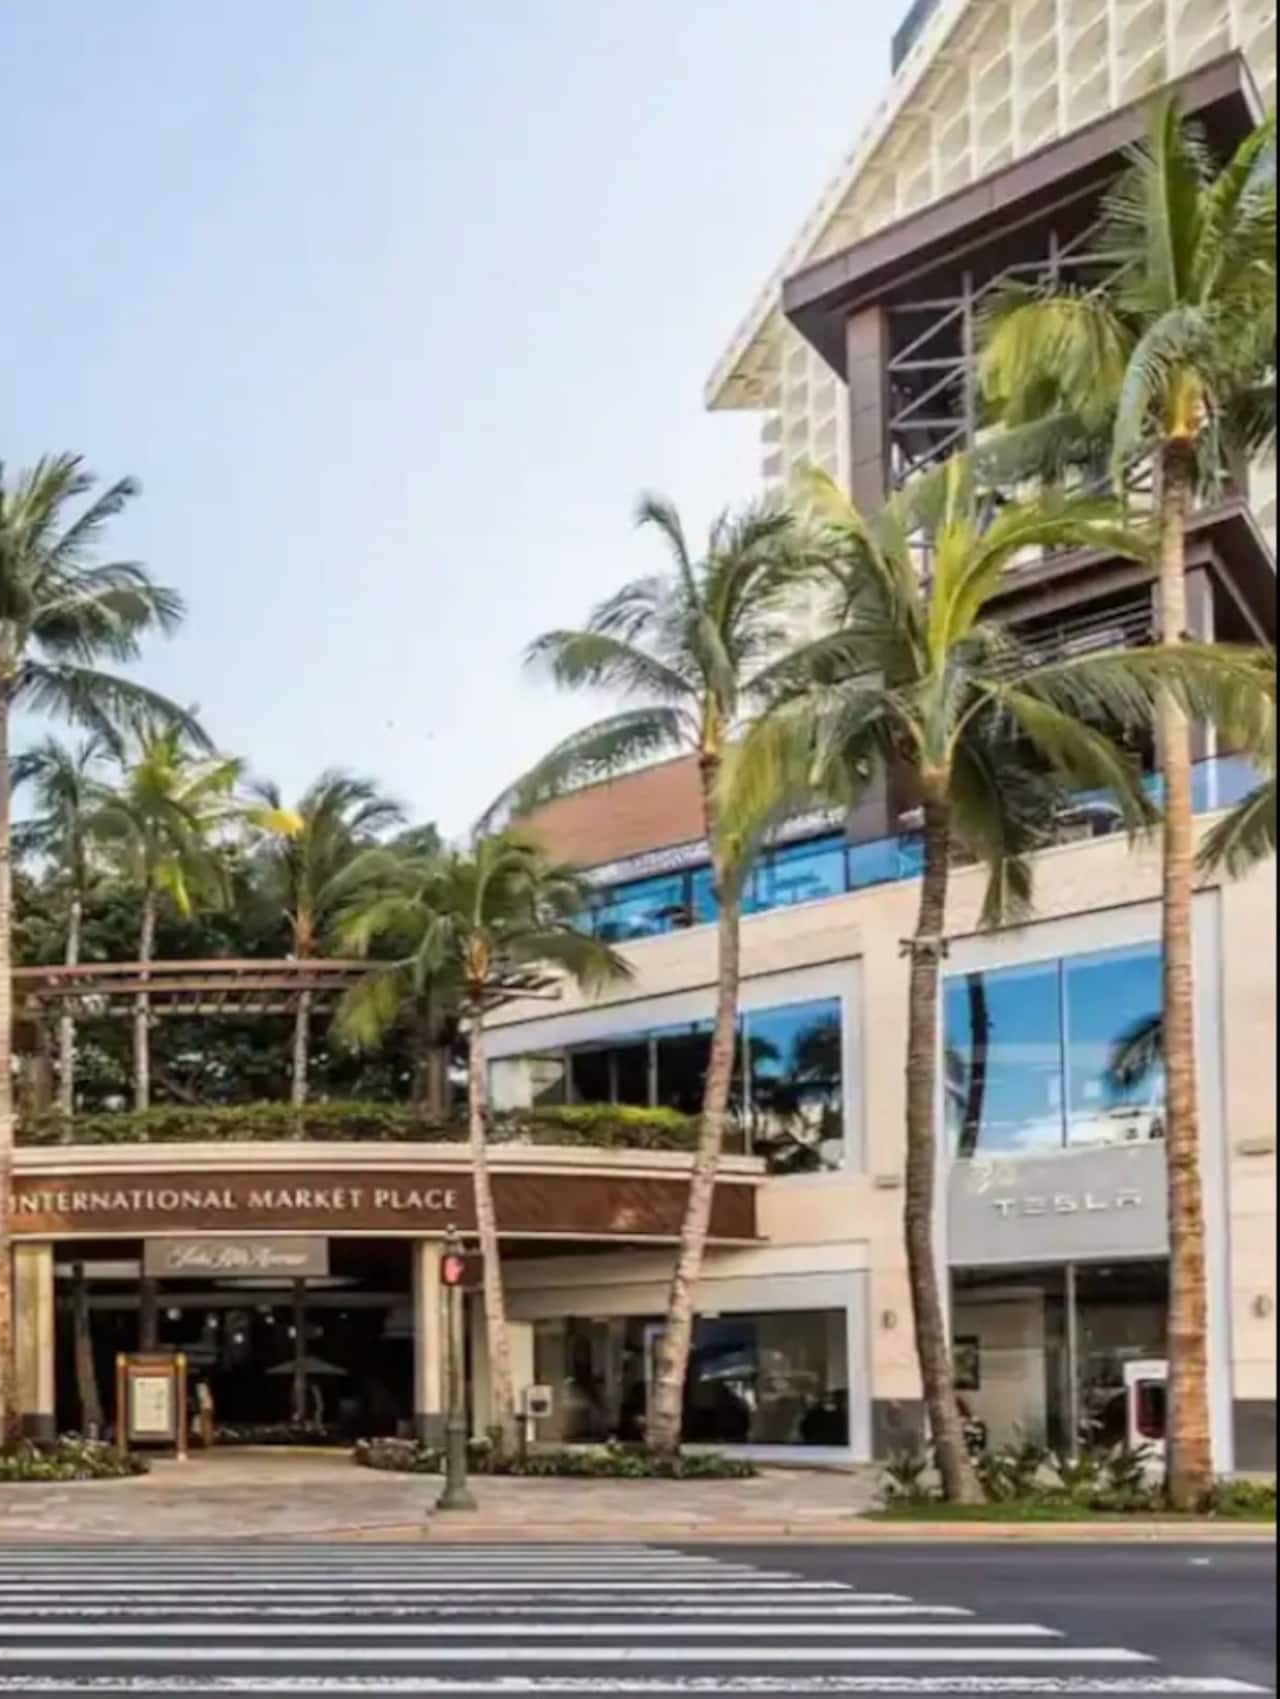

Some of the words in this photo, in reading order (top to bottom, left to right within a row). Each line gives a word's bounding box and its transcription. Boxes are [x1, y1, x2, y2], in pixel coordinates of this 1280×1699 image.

[9, 1189, 237, 1213] INTERNATIONAL
[247, 1188, 363, 1210] MARKET
[373, 1188, 457, 1210] PLACE
[991, 1187, 1142, 1216] TESLA
